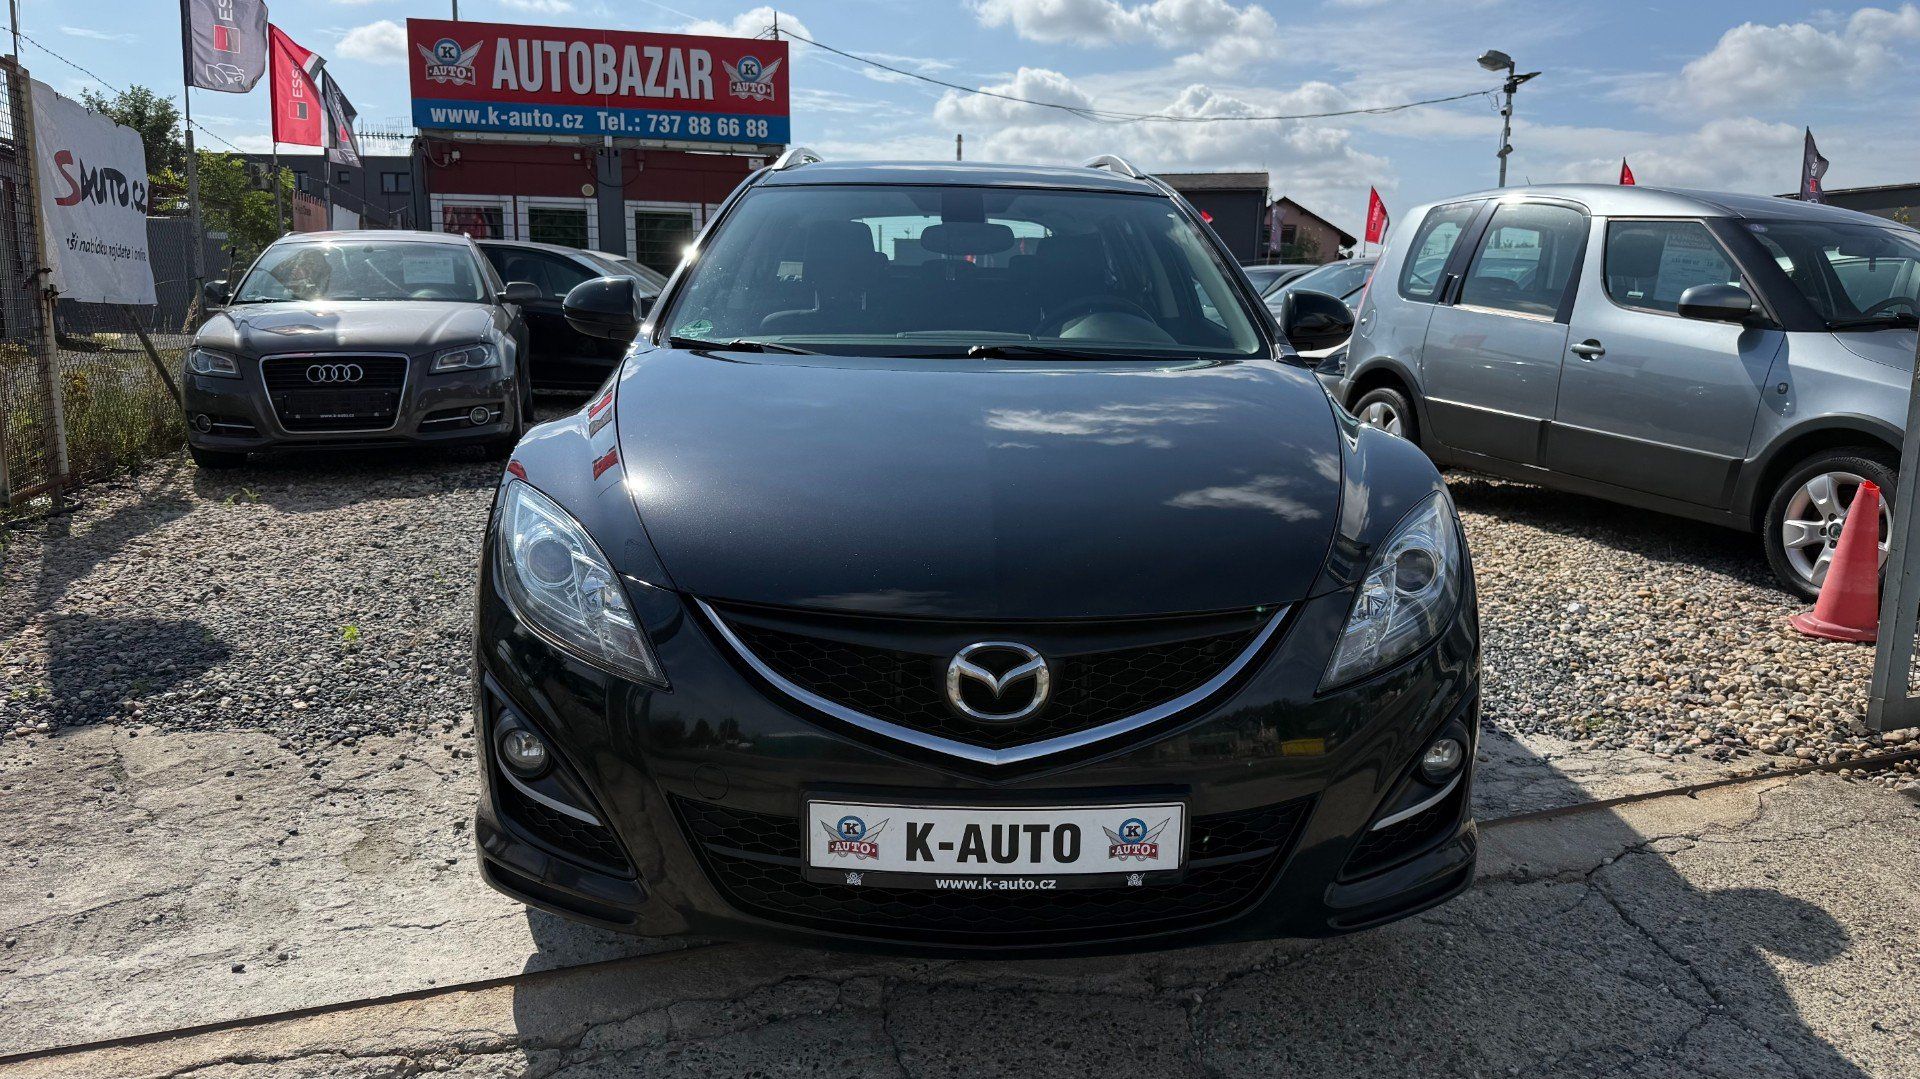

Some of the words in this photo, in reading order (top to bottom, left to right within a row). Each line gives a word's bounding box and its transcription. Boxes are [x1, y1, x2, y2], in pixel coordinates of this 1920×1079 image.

[441, 46, 455, 59] K
[432, 65, 467, 79] AUTO
[492, 37, 714, 100] AUTOBAZAR
[743, 63, 756, 76] K
[735, 82, 766, 95] AUTO
[431, 106, 584, 129] www.k-auto.cz
[597, 111, 640, 132] Tel.:
[647, 114, 681, 134] 737
[688, 116, 711, 135] 88
[717, 118, 740, 137] 66
[746, 119, 768, 138] 88
[844, 822, 859, 835] K
[1126, 825, 1140, 838] K
[834, 841, 871, 854] AUTO
[905, 822, 1081, 864] K-AUTO
[1115, 844, 1150, 856] AUTO
[936, 877, 1057, 890] www.k-auto.cz
